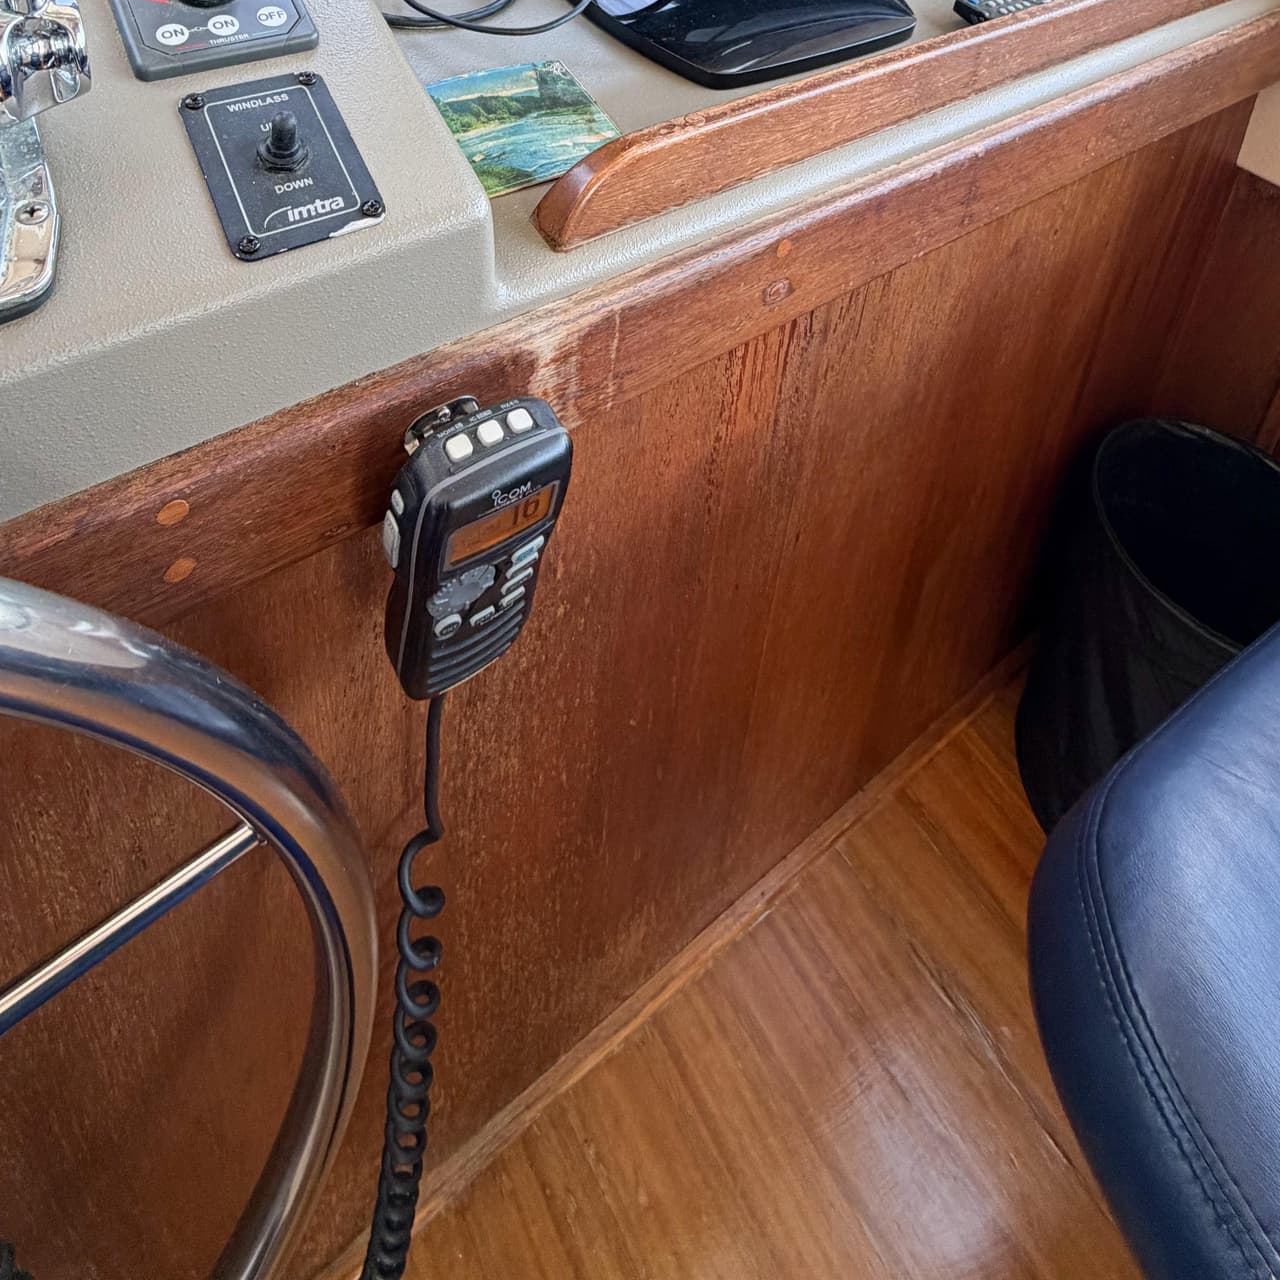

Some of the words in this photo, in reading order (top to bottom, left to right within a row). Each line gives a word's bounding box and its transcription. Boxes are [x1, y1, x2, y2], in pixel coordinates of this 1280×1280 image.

[258, 10, 285, 22] OFF
[161, 28, 185, 40] ON
[212, 19, 236, 30] ON
[208, 33, 249, 46] THRUSTER
[226, 93, 289, 113] WINDLASS
[260, 122, 273, 132] U
[274, 177, 314, 194] DOWN
[287, 196, 345, 222] imtra
